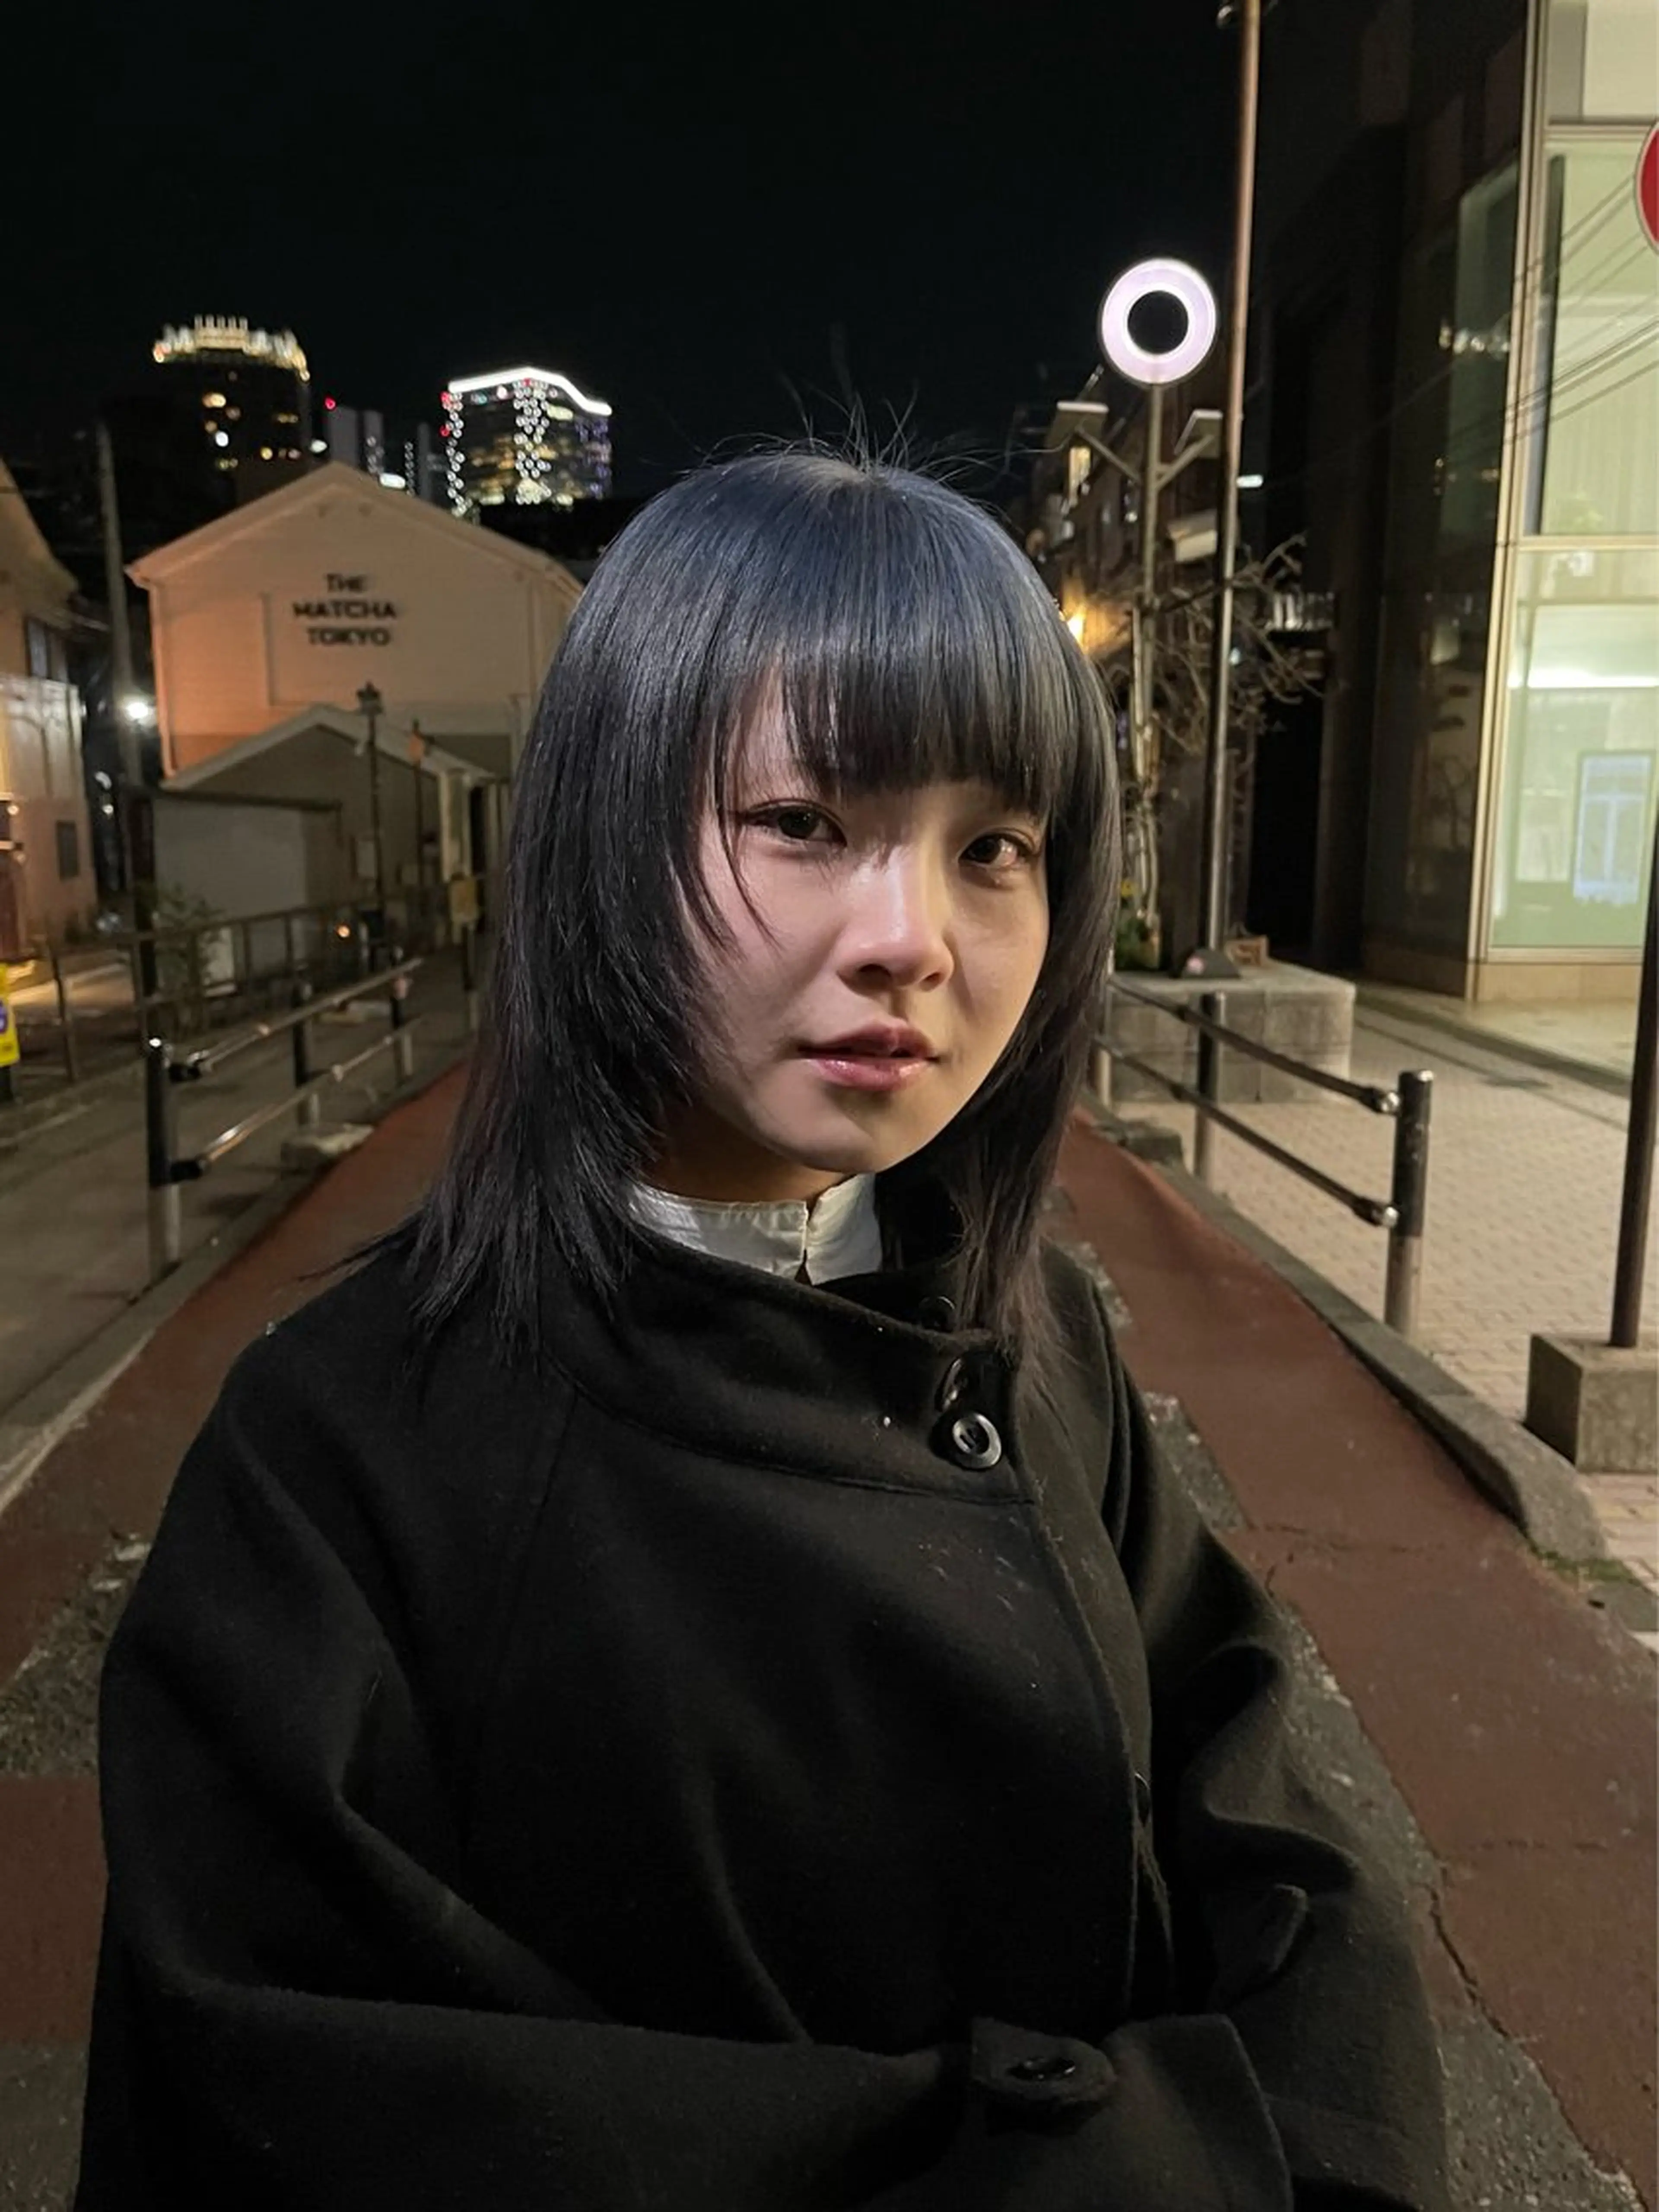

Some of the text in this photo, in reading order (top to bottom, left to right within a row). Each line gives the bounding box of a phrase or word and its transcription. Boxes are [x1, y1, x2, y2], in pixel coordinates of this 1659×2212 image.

[326, 572, 365, 592] THE
[292, 600, 397, 619] MATCHA
[307, 627, 391, 646] TOKYO
